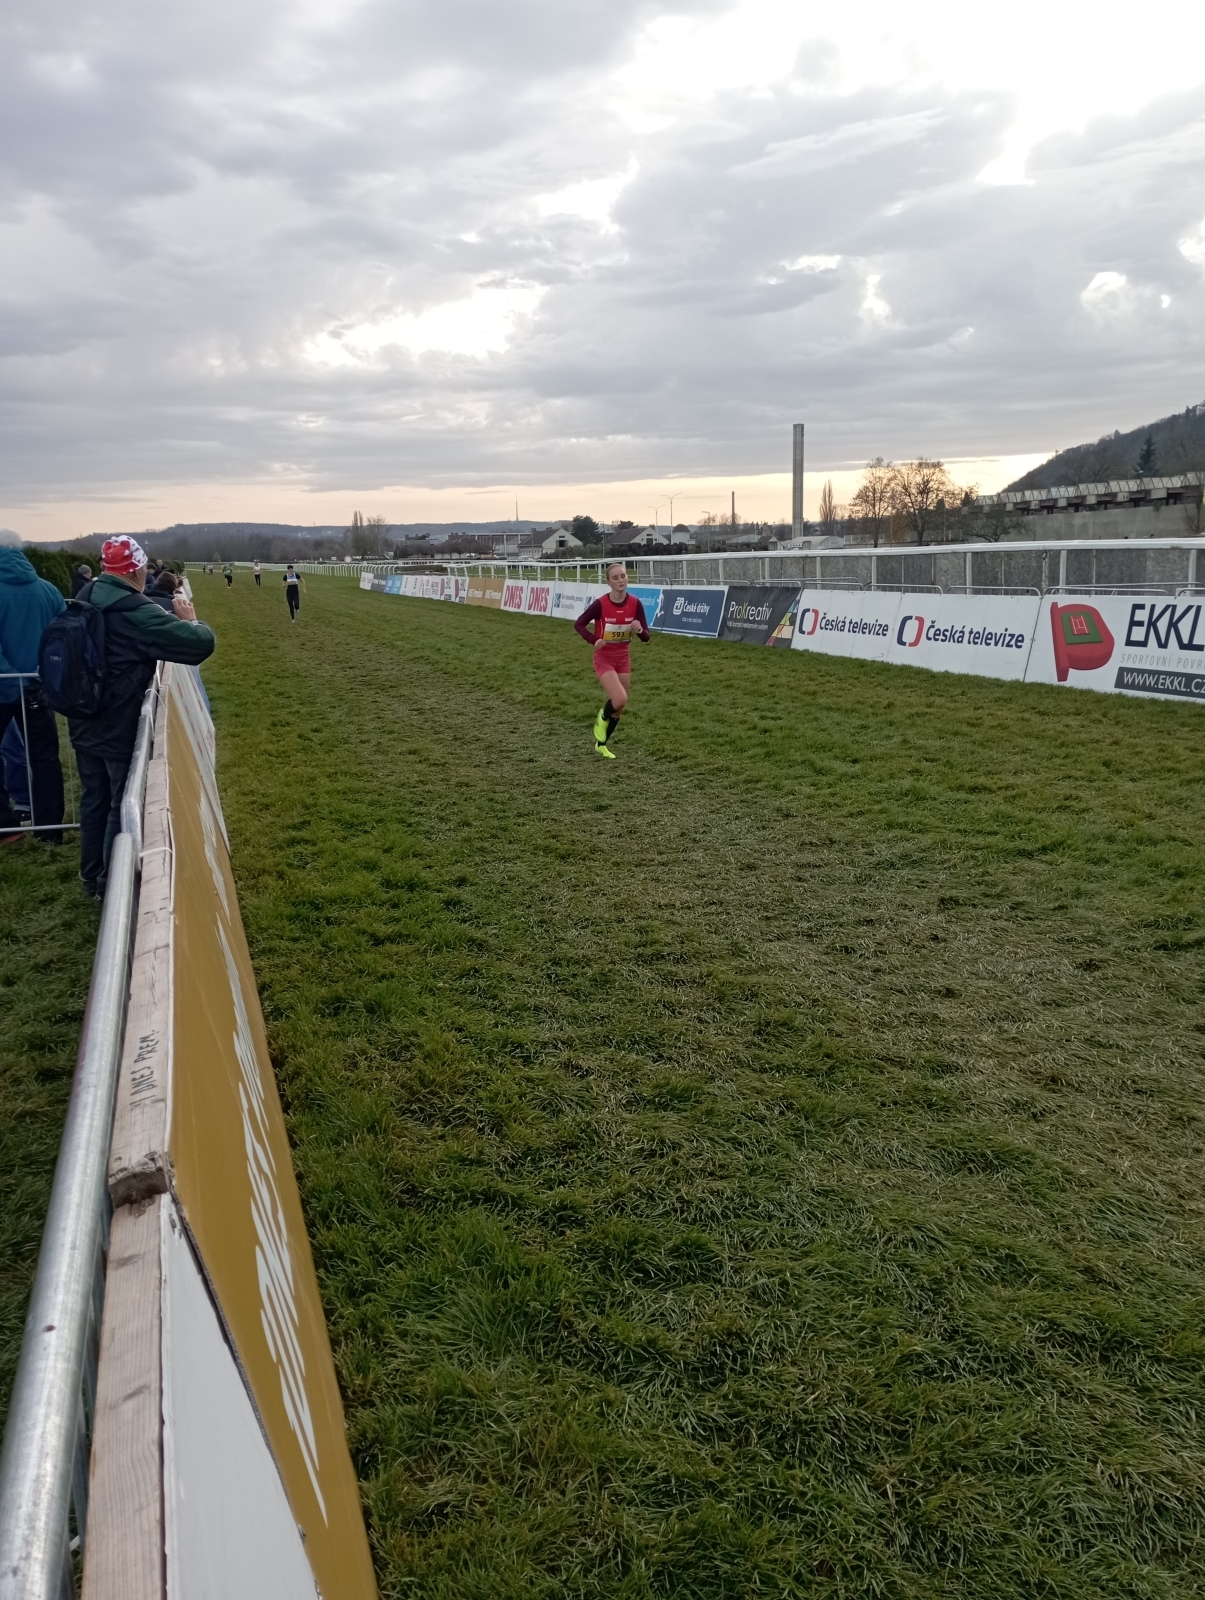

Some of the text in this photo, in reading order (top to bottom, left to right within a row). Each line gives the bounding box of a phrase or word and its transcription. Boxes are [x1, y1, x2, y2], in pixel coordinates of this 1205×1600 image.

[503, 585, 523, 610] DNES
[527, 586, 550, 613] DNES
[683, 601, 710, 616] České dráhy
[727, 601, 773, 621] ProKreativ
[819, 612, 889, 637] Česká televize
[925, 620, 1025, 649] Česká televize
[1124, 603, 1205, 652] EKKL
[1120, 653, 1205, 670] SPORTOVNÍ POVR
